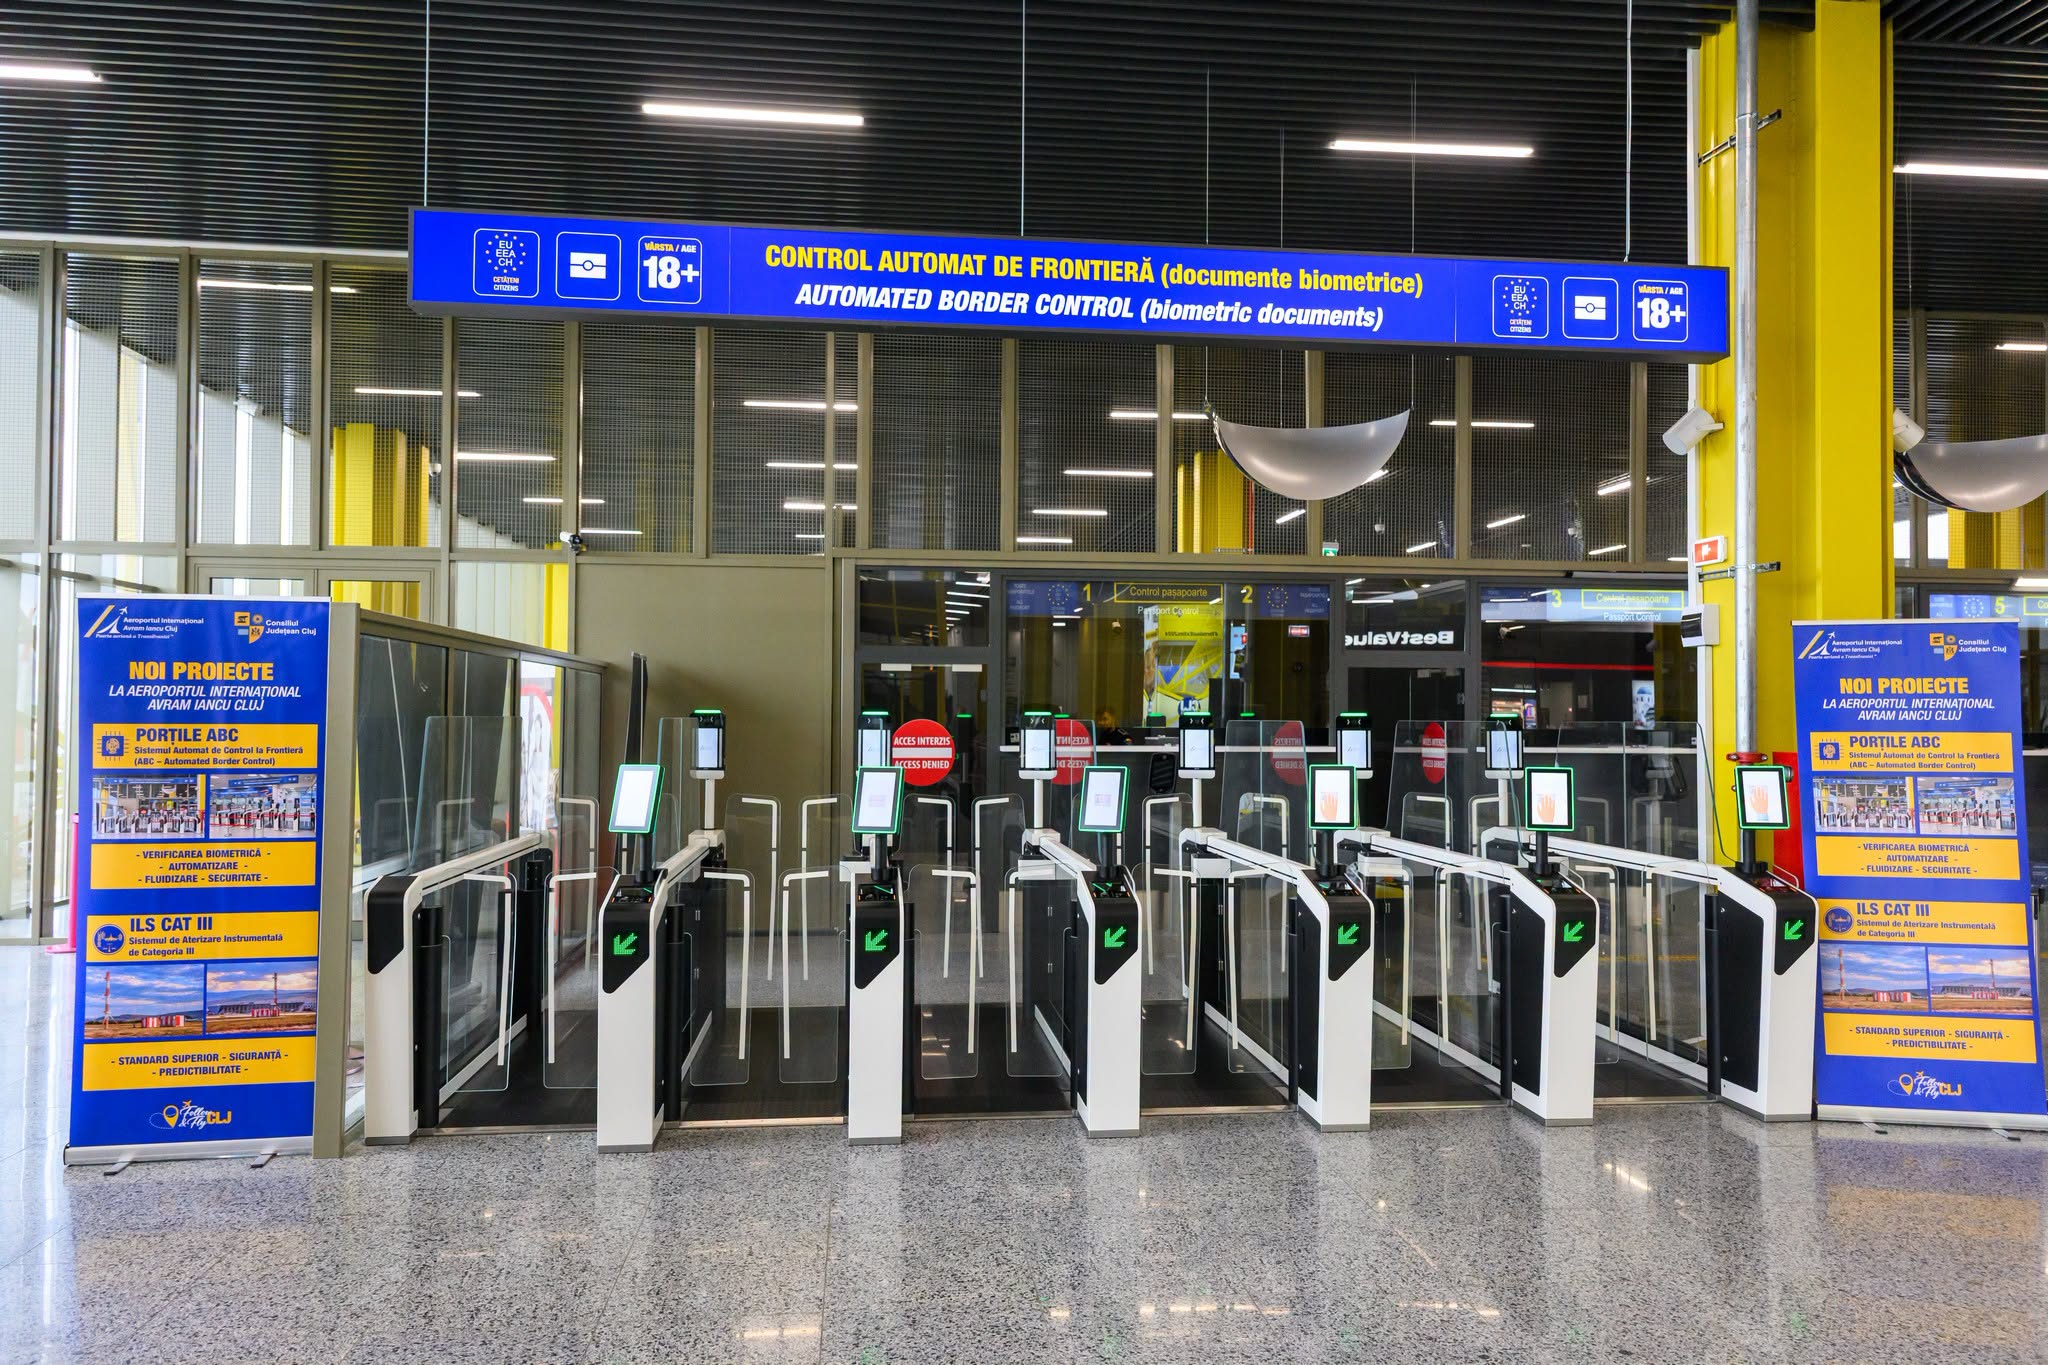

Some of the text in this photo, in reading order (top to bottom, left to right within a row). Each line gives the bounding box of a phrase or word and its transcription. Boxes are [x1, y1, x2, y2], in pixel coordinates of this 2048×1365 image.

[496, 249, 516, 257] EEA
[681, 244, 697, 252] AGE
[498, 258, 513, 266] CH
[644, 256, 700, 289] 18+
[766, 245, 1423, 298] CONTROL AUTOMAT DE FRONTIERĂ (documente biometrice)
[1669, 287, 1683, 295] AGE
[794, 284, 1384, 331] AUTOMATED BORDER CONTROL (biometric documents)
[1637, 298, 1686, 329] 18+
[1083, 584, 1091, 602] 1
[1130, 586, 1160, 596] Control
[1242, 584, 1253, 603] 2
[1552, 590, 1562, 608] 3
[1995, 596, 2006, 614] 5
[123, 617, 160, 626] Aeroportul
[301, 628, 316, 636] Cluj
[129, 662, 274, 680] NOI PROIECTE
[1840, 678, 1969, 694] NOI PROIECTE
[109, 685, 302, 700] LA AEROPORTUL INTERNAȚIONAL
[147, 699, 265, 711] AVRAM IANCU CLUJ
[1823, 698, 1994, 711] LA AEROPORTUL INTERNAȚIONAL
[1858, 710, 1962, 721] AVRAM IANCU CLUJ
[136, 728, 239, 745] PORȚILE ABC
[894, 736, 950, 745] ACCES INTERZIS
[1850, 736, 1941, 751] PORȚILE ABC
[134, 758, 154, 766] (ABC
[242, 758, 275, 766] Control)
[922, 760, 950, 768] DENIED
[1945, 762, 1976, 770] Control)
[142, 850, 203, 859] VERIFICAREA
[168, 862, 238, 870] AUTOMATIZARE
[1922, 866, 1971, 874] SECURITATE
[145, 874, 261, 883] FLUIDIZARE SECURITATE
[1857, 902, 1930, 916] ILS CAT III
[130, 916, 212, 932] ILS CAT III
[182, 935, 221, 943] Aterizare
[1868, 930, 1905, 938] Categoria
[142, 948, 183, 957] Categoria
[1856, 1026, 1900, 1035] STANDARD
[1903, 1028, 1946, 1037] SUPERIOR
[1892, 1040, 1966, 1050] PREDICTIBILITATE
[118, 1055, 169, 1065] STANDARD
[172, 1053, 219, 1063] SUPERIOR
[160, 1065, 241, 1076] PREDICTIBILITATE
[1939, 1083, 1962, 1096] CLJ
[206, 1111, 232, 1124] CLJ
